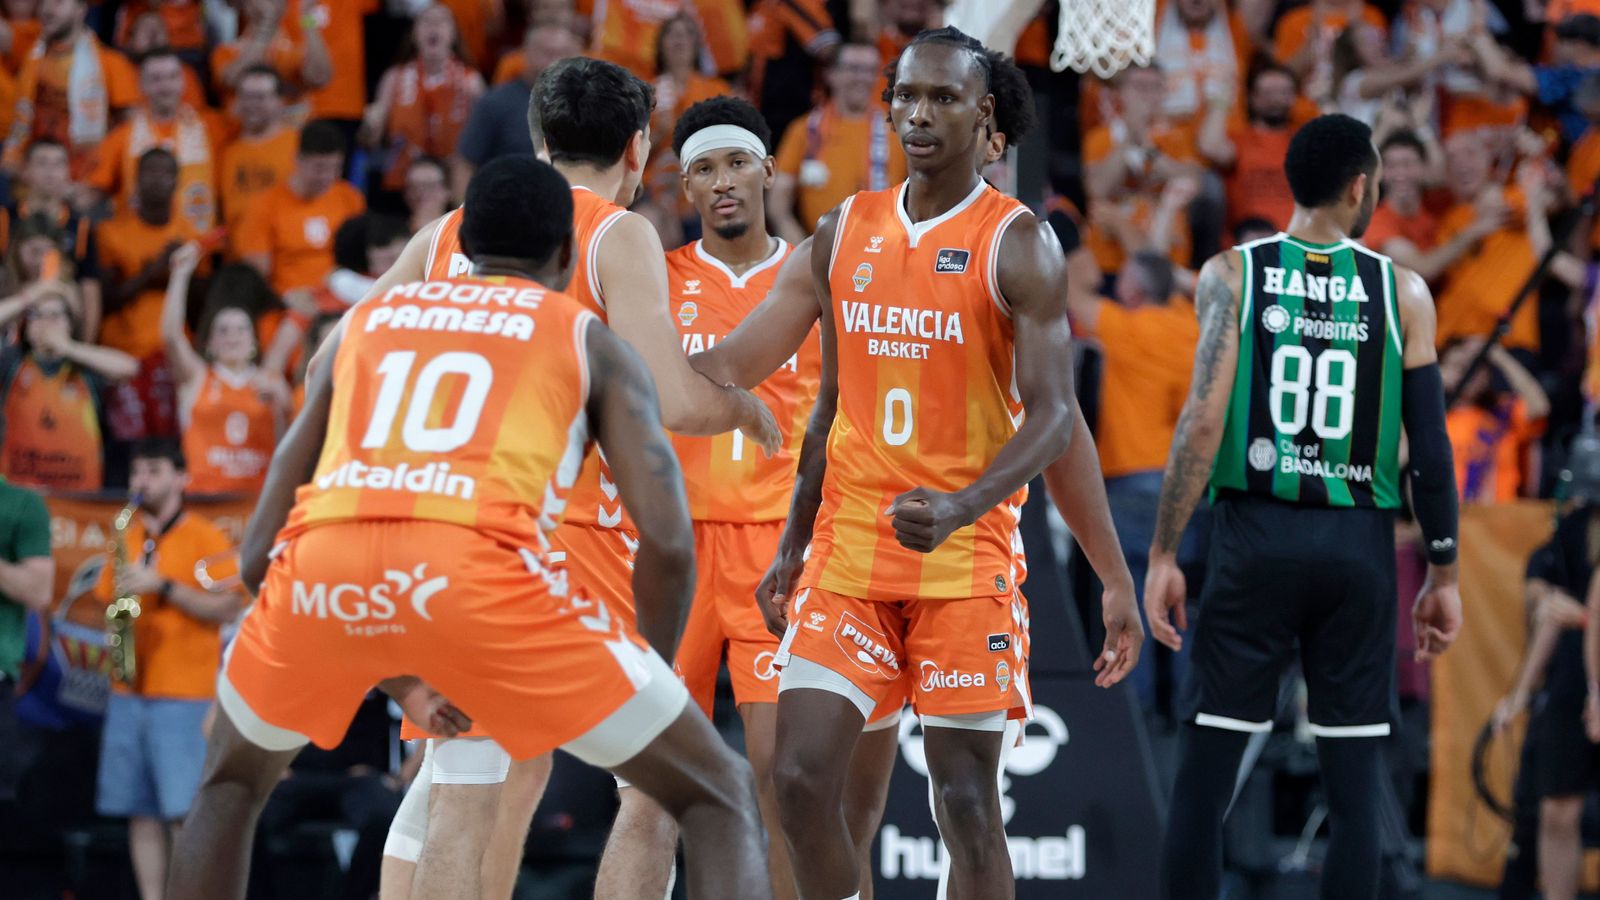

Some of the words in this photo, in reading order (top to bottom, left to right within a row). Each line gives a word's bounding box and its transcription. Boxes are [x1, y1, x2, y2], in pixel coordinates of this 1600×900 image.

[382, 281, 546, 310] MOORE
[1262, 266, 1370, 303] HANGA
[364, 305, 535, 341] PAMESA
[841, 300, 964, 345] VALENCIA
[1292, 316, 1369, 342] PROBITAS
[868, 338, 930, 360] BASKET
[360, 350, 494, 452] 10
[1268, 344, 1357, 440] 88
[882, 387, 913, 446] 0
[1280, 440, 1302, 456] City
[1280, 456, 1372, 482] BADALONA
[292, 580, 397, 622] MGS
[990, 640, 1007, 650] acb
[920, 661, 986, 692] Midea
